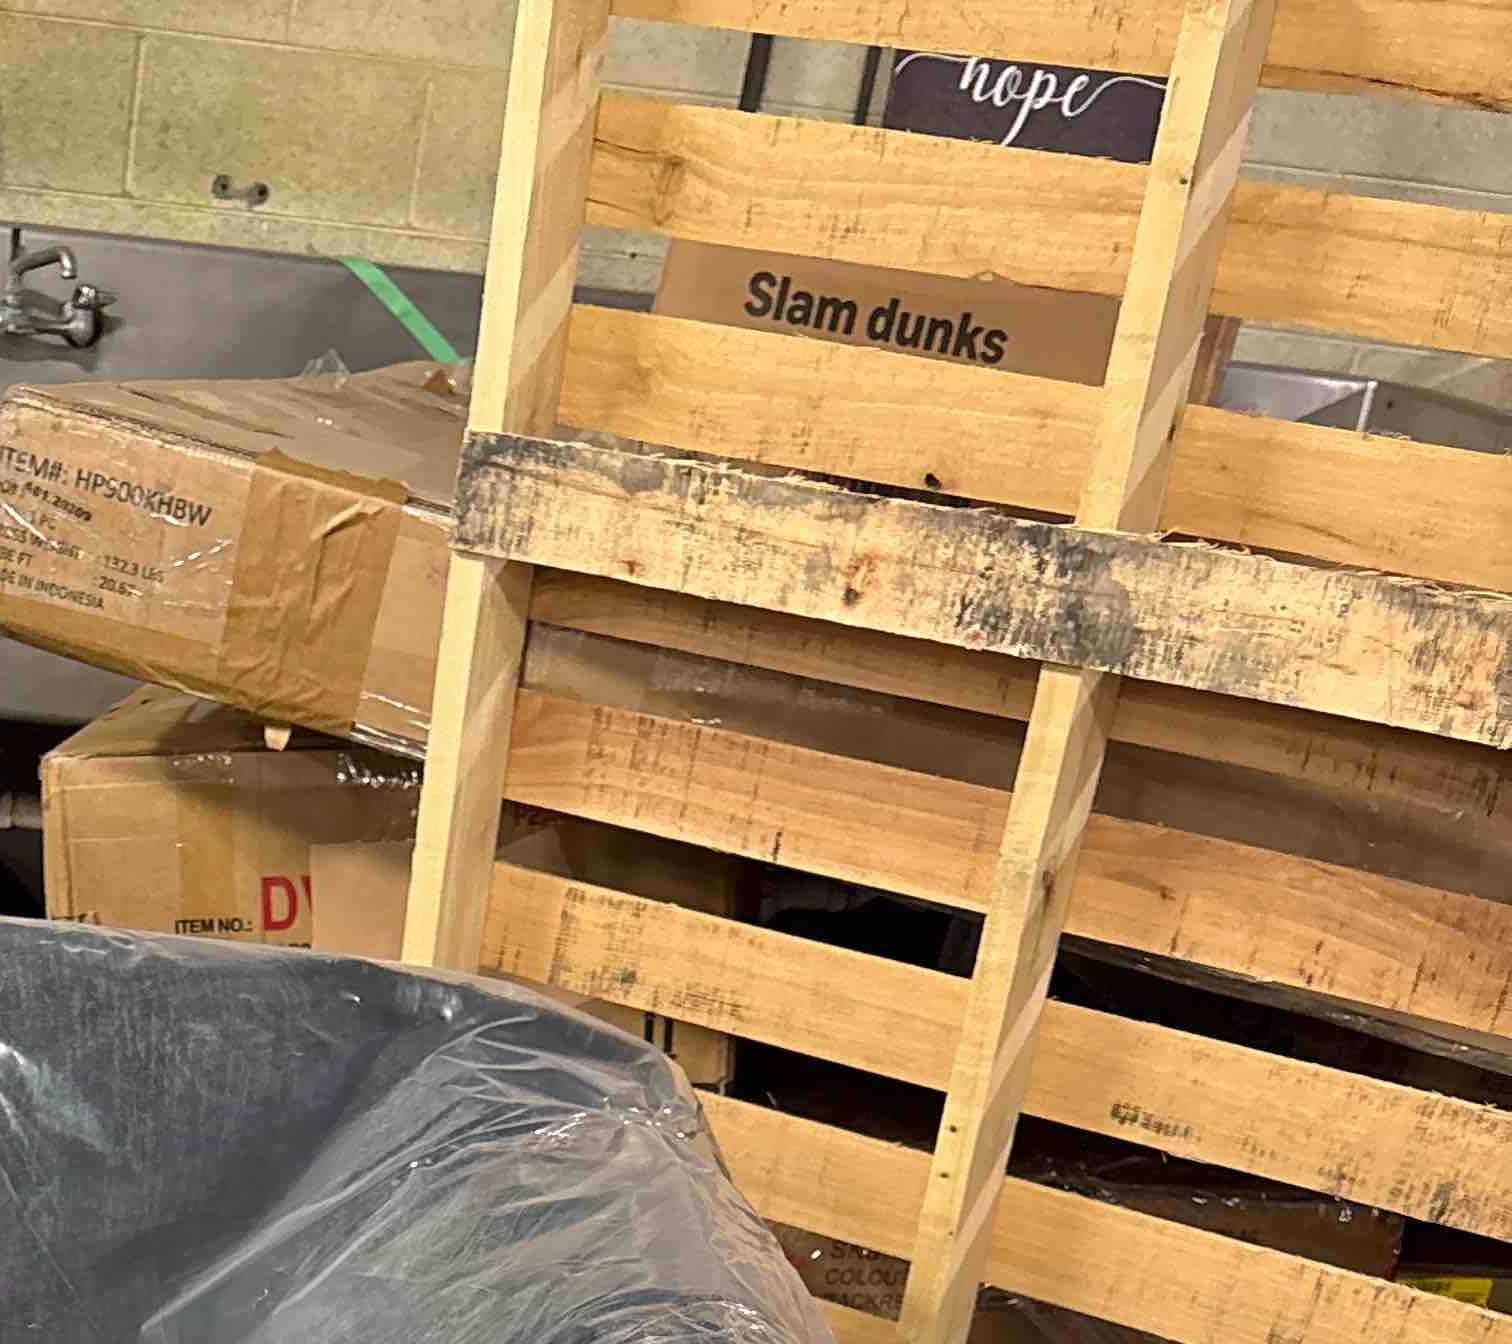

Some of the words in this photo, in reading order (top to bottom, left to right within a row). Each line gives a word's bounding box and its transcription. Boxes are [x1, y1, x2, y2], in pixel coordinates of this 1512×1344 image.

[744, 271, 858, 336] Slam
[866, 297, 1009, 364] dunks
[174, 918, 215, 935] ITEM
[218, 917, 252, 934] NO.:
